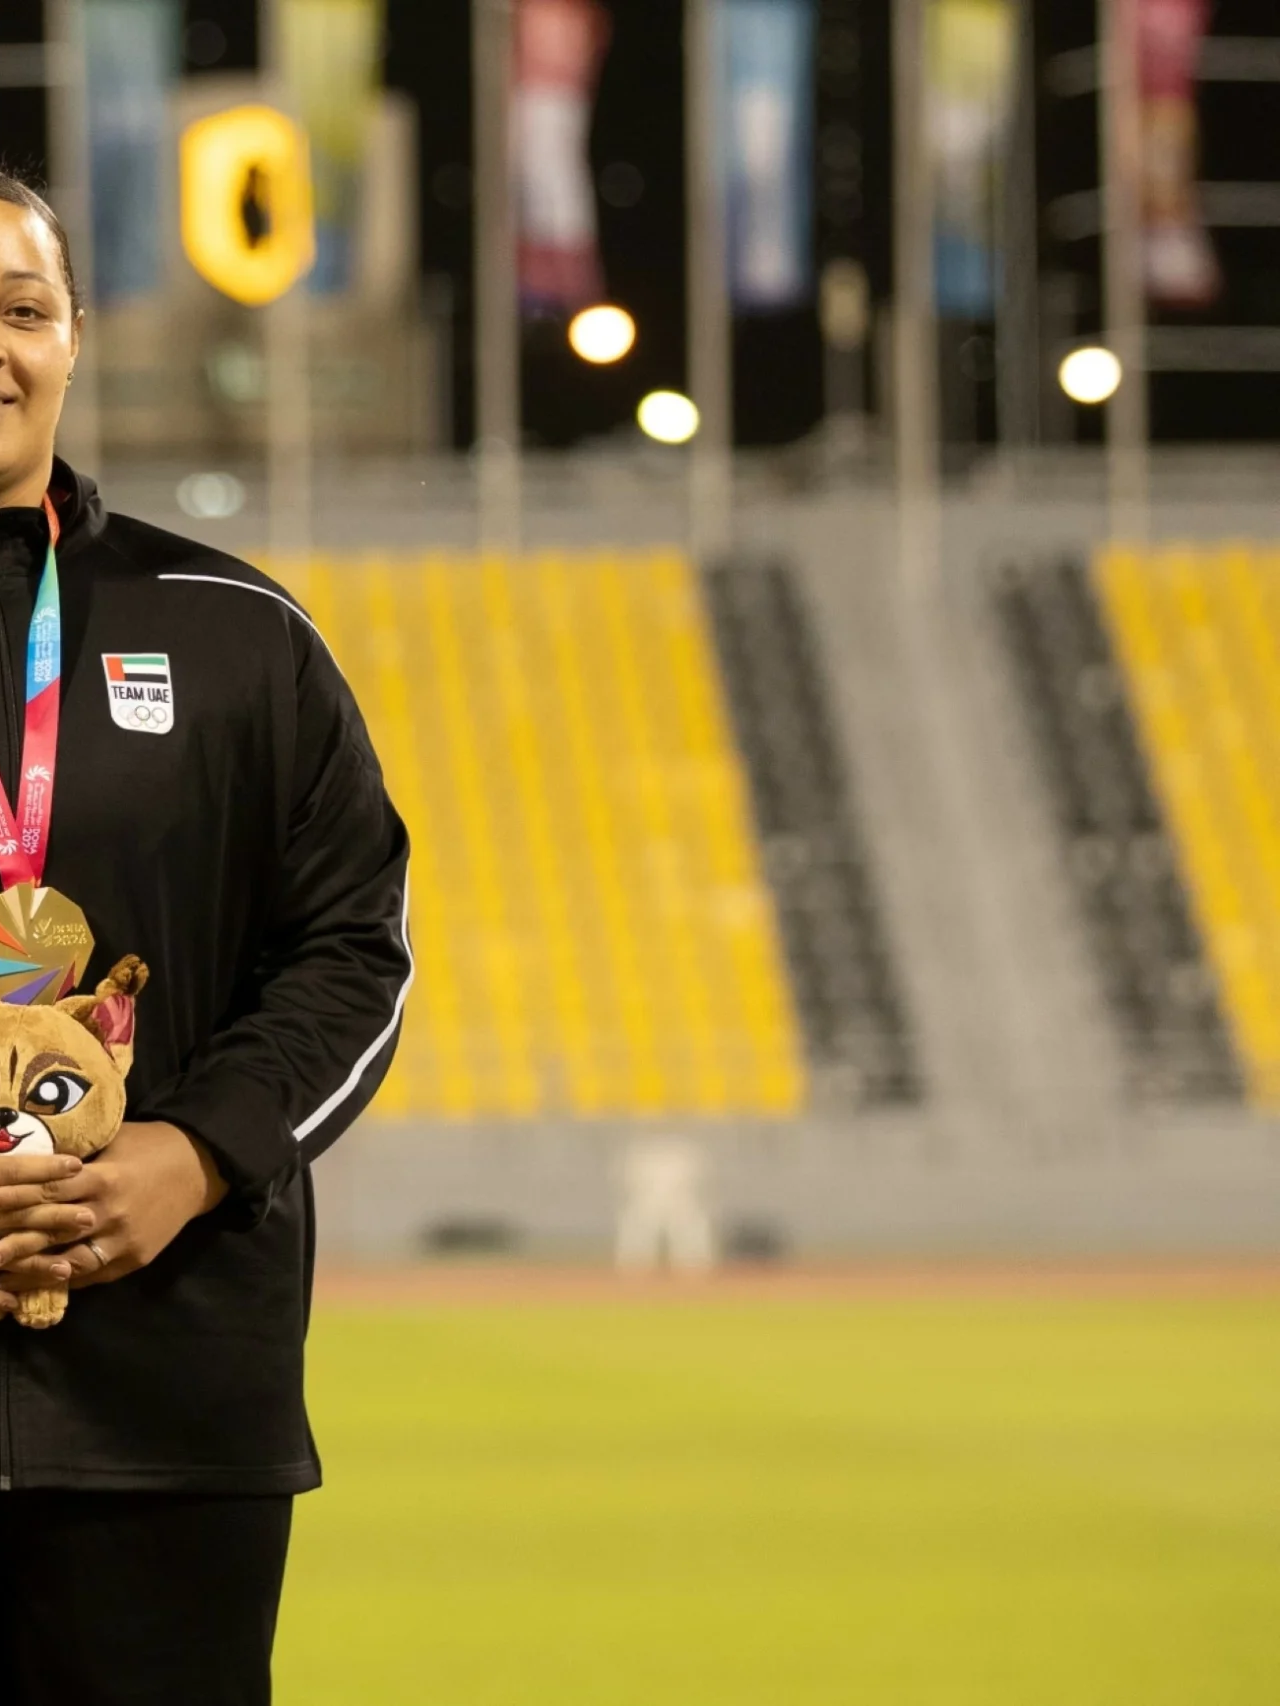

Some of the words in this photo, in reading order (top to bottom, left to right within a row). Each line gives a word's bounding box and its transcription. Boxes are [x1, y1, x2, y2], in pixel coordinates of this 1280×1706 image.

[111, 685, 144, 701] TEAM
[147, 687, 170, 704] UAE
[30, 828, 41, 855] DOHA
